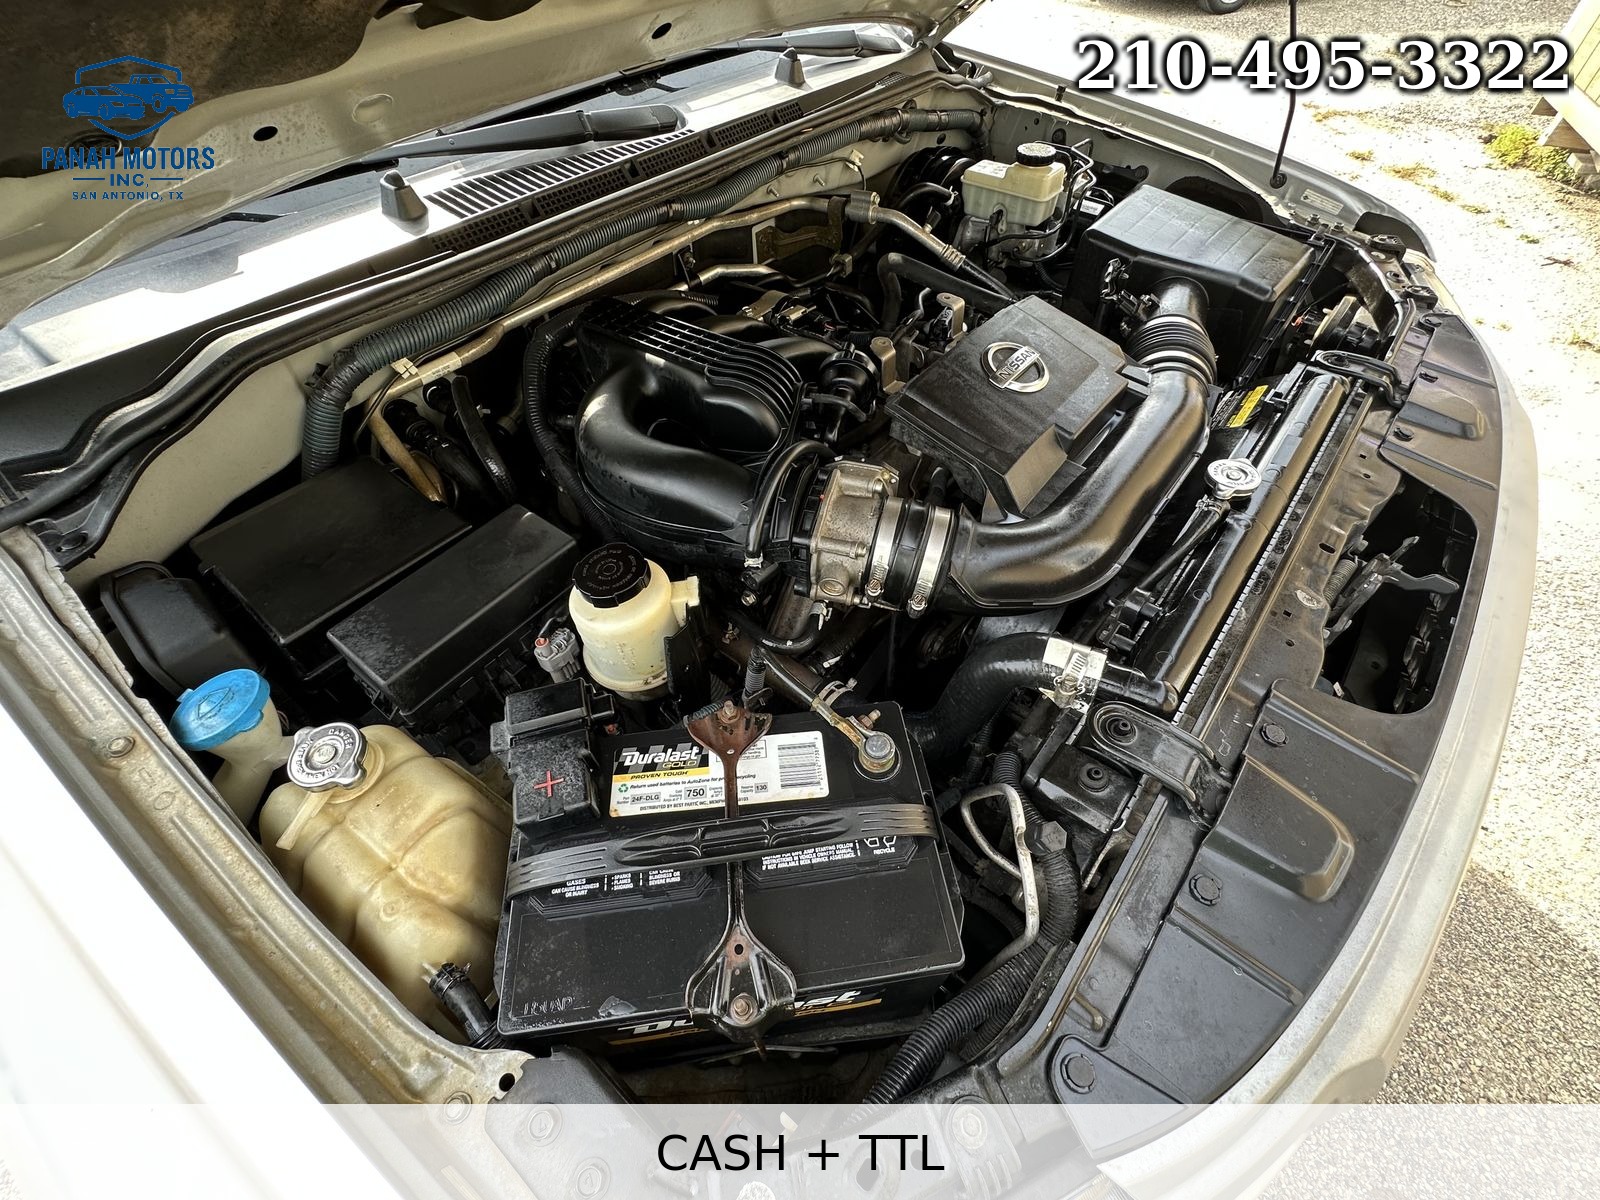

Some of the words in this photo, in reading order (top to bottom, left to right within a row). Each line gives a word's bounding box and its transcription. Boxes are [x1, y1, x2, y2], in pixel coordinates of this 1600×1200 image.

[998, 350, 1036, 381] NISSAN
[328, 728, 354, 749] DANGER
[622, 746, 700, 766] Duralast
[662, 760, 697, 769] GOLD
[631, 794, 660, 802] 24F-DLG
[686, 788, 705, 798] 750
[815, 845, 836, 853] STARTING
[836, 842, 854, 850] FOLLOW
[873, 847, 896, 855] RECYCLE
[648, 873, 672, 881] BLINDNESS
[561, 885, 576, 893] CAUSE
[575, 882, 600, 891] BLINDNESS
